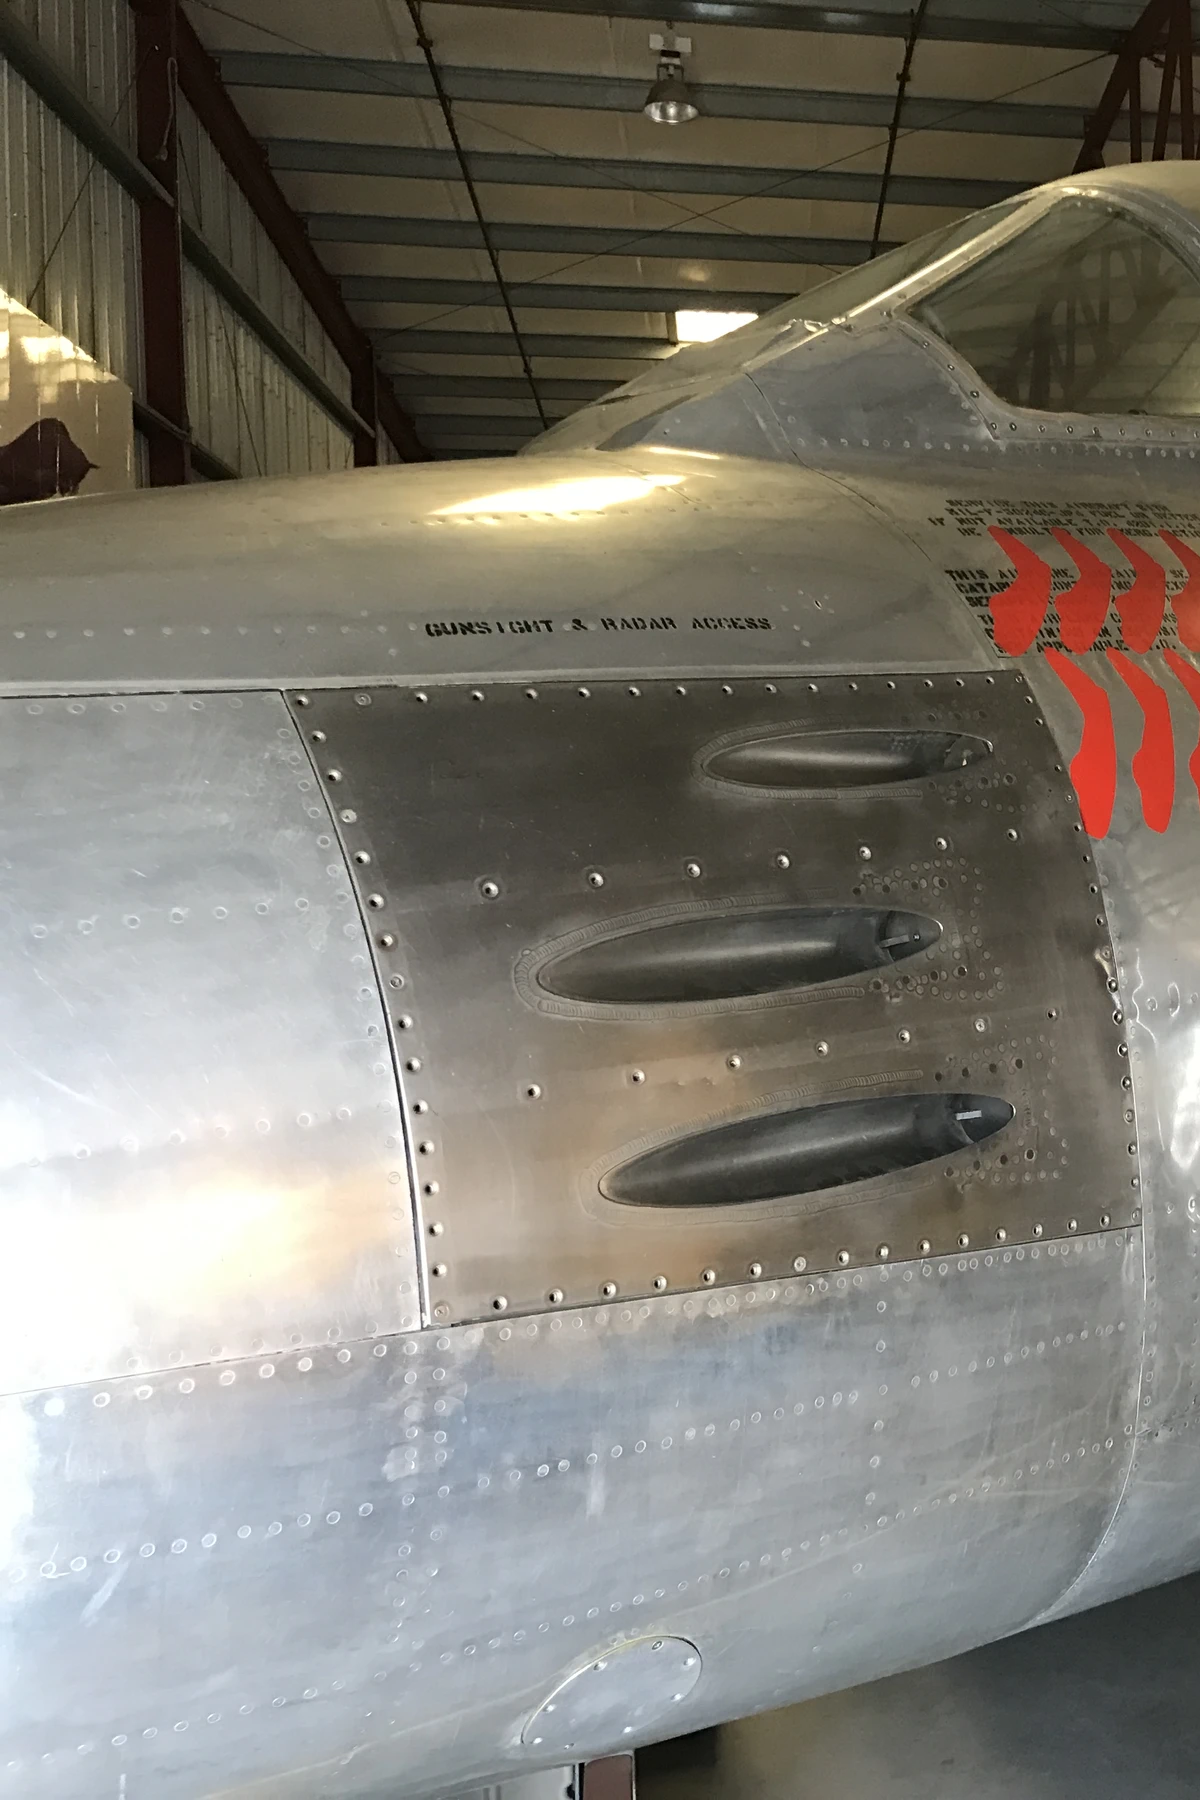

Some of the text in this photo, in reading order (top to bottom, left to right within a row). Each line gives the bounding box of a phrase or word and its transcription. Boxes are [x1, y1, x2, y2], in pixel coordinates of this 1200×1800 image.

[954, 517, 987, 526] NOT
[944, 568, 990, 582] THIS
[425, 616, 774, 638] GUNSIGHT & RADAR ACCESS
